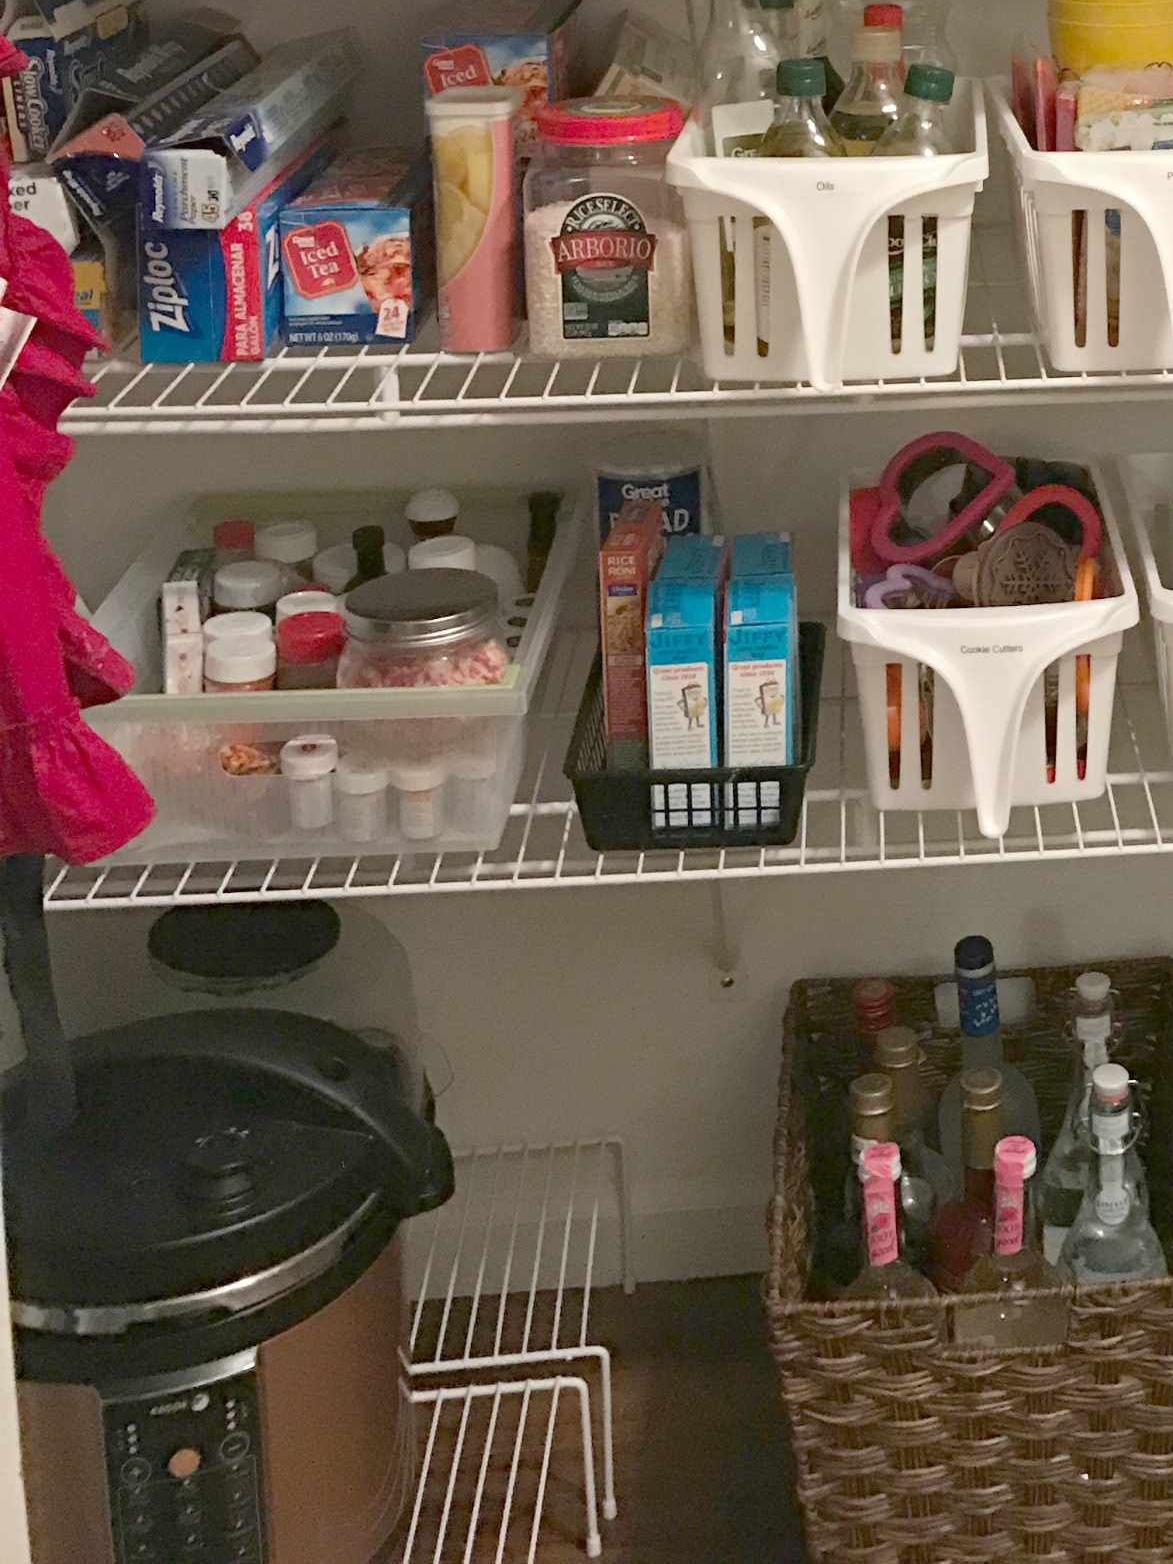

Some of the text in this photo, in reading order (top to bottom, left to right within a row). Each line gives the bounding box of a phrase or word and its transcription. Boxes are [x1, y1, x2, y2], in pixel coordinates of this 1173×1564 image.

[440, 63, 479, 88] Iced
[27, 97, 49, 152] Cooker
[179, 157, 189, 222] Parchment
[816, 180, 835, 192] Oils
[11, 200, 30, 211] er
[151, 173, 165, 223] Reynolds
[188, 194, 198, 224] Paper
[566, 197, 641, 230] RICESELECT
[299, 240, 340, 266] Iced
[557, 236, 652, 263] ARBORIO
[307, 261, 341, 279] Tea
[144, 241, 190, 333] Ziploc
[229, 242, 249, 357] PARA ALMACENAR
[382, 305, 400, 321] 24
[289, 332, 304, 343] NET
[304, 332, 317, 343] WT
[324, 332, 335, 343] OZ
[621, 482, 671, 501] Great
[607, 555, 636, 567] RICE
[607, 566, 637, 577] RONI
[650, 631, 708, 650] JIFFY
[729, 628, 787, 647] JIFFY
[960, 642, 1024, 655] Cookie Cutters
